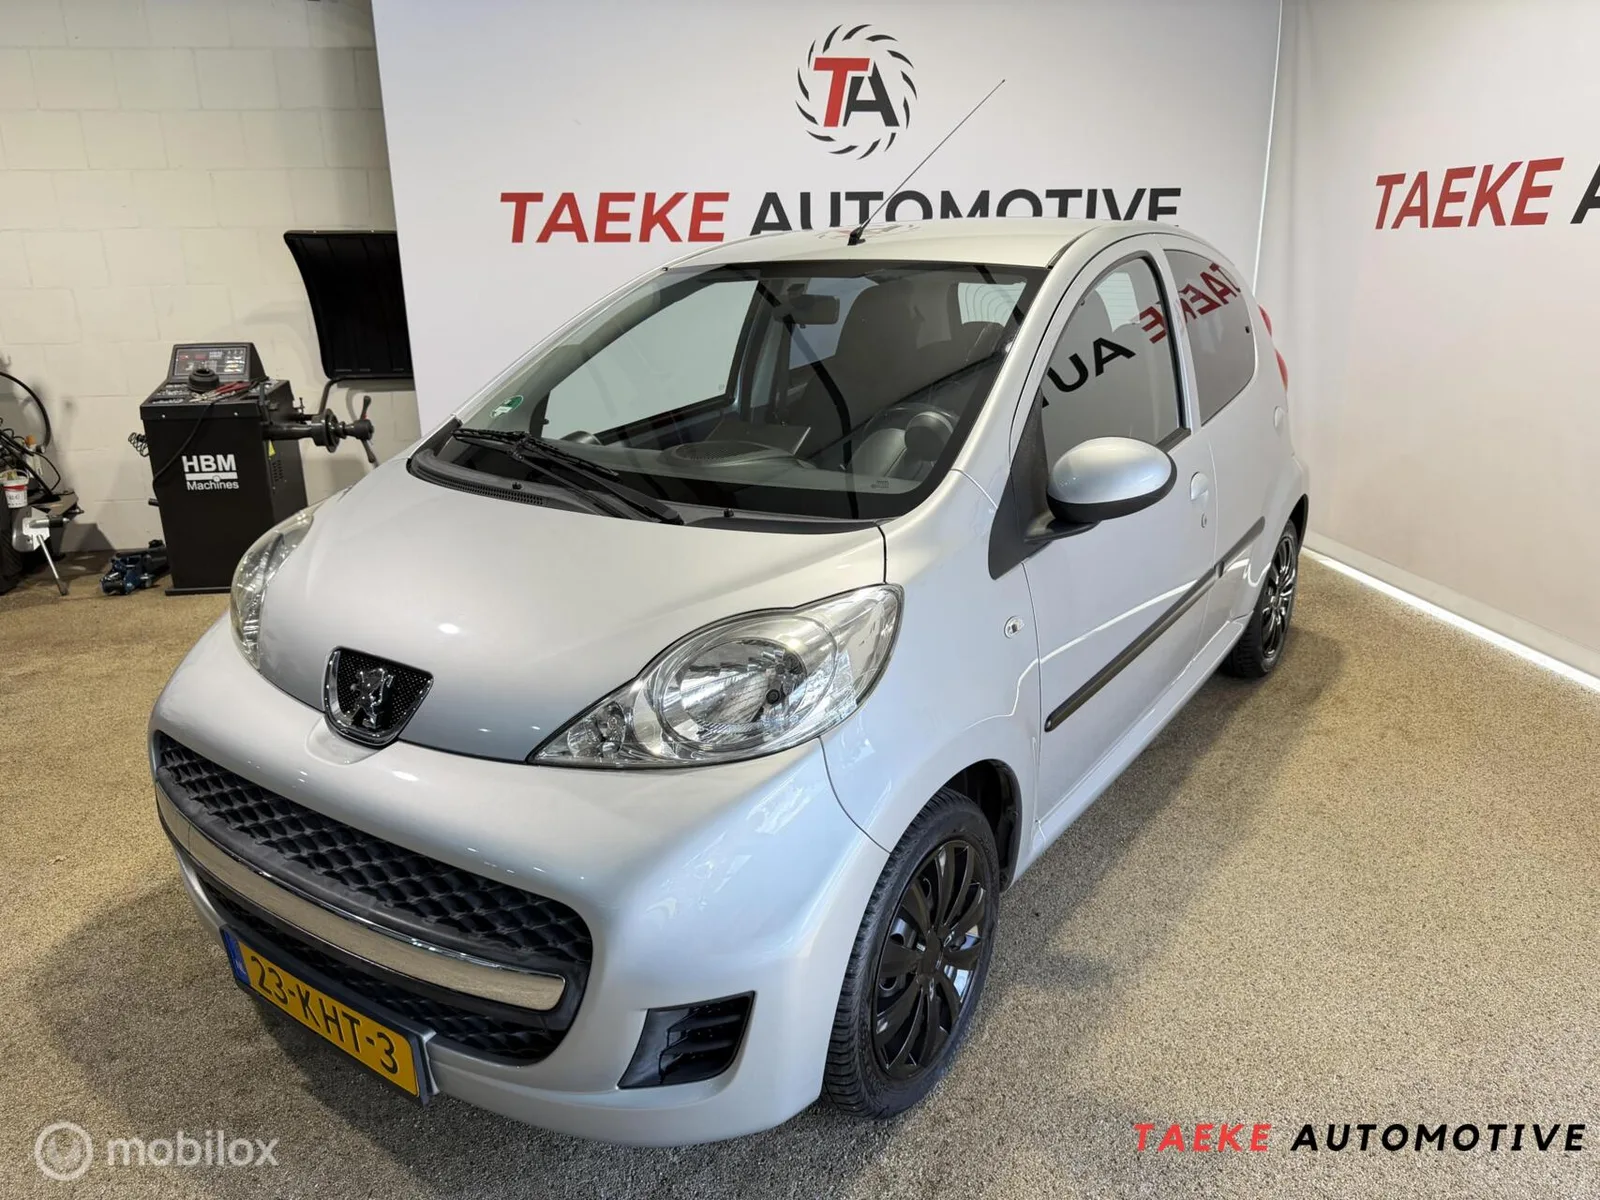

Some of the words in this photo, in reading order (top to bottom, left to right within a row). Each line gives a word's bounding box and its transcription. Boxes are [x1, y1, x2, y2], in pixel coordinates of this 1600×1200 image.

[814, 58, 899, 127] TA
[500, 192, 729, 243] TAEKE
[750, 188, 1182, 236] AUTOMOTIVE
[1375, 157, 1564, 229] TAEKE
[181, 454, 237, 473] HBM
[186, 480, 239, 491] Machines
[250, 955, 399, 1075] 23-KHT-3
